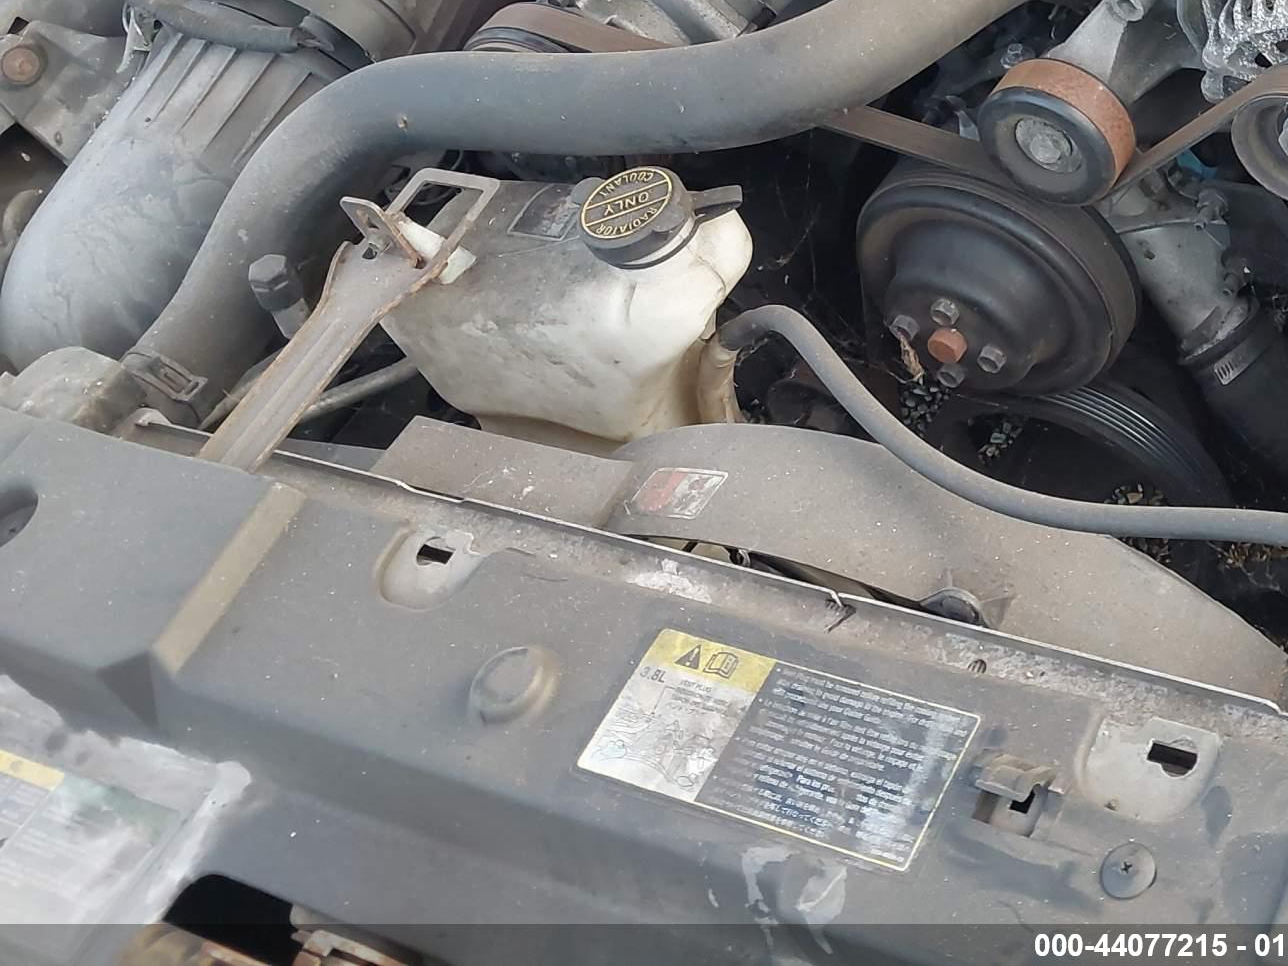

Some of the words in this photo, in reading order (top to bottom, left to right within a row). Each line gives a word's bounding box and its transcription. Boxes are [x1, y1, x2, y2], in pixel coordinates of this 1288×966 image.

[604, 191, 650, 217] ONLY
[596, 207, 658, 235] RADIATOR
[640, 666, 666, 682] 3.8L
